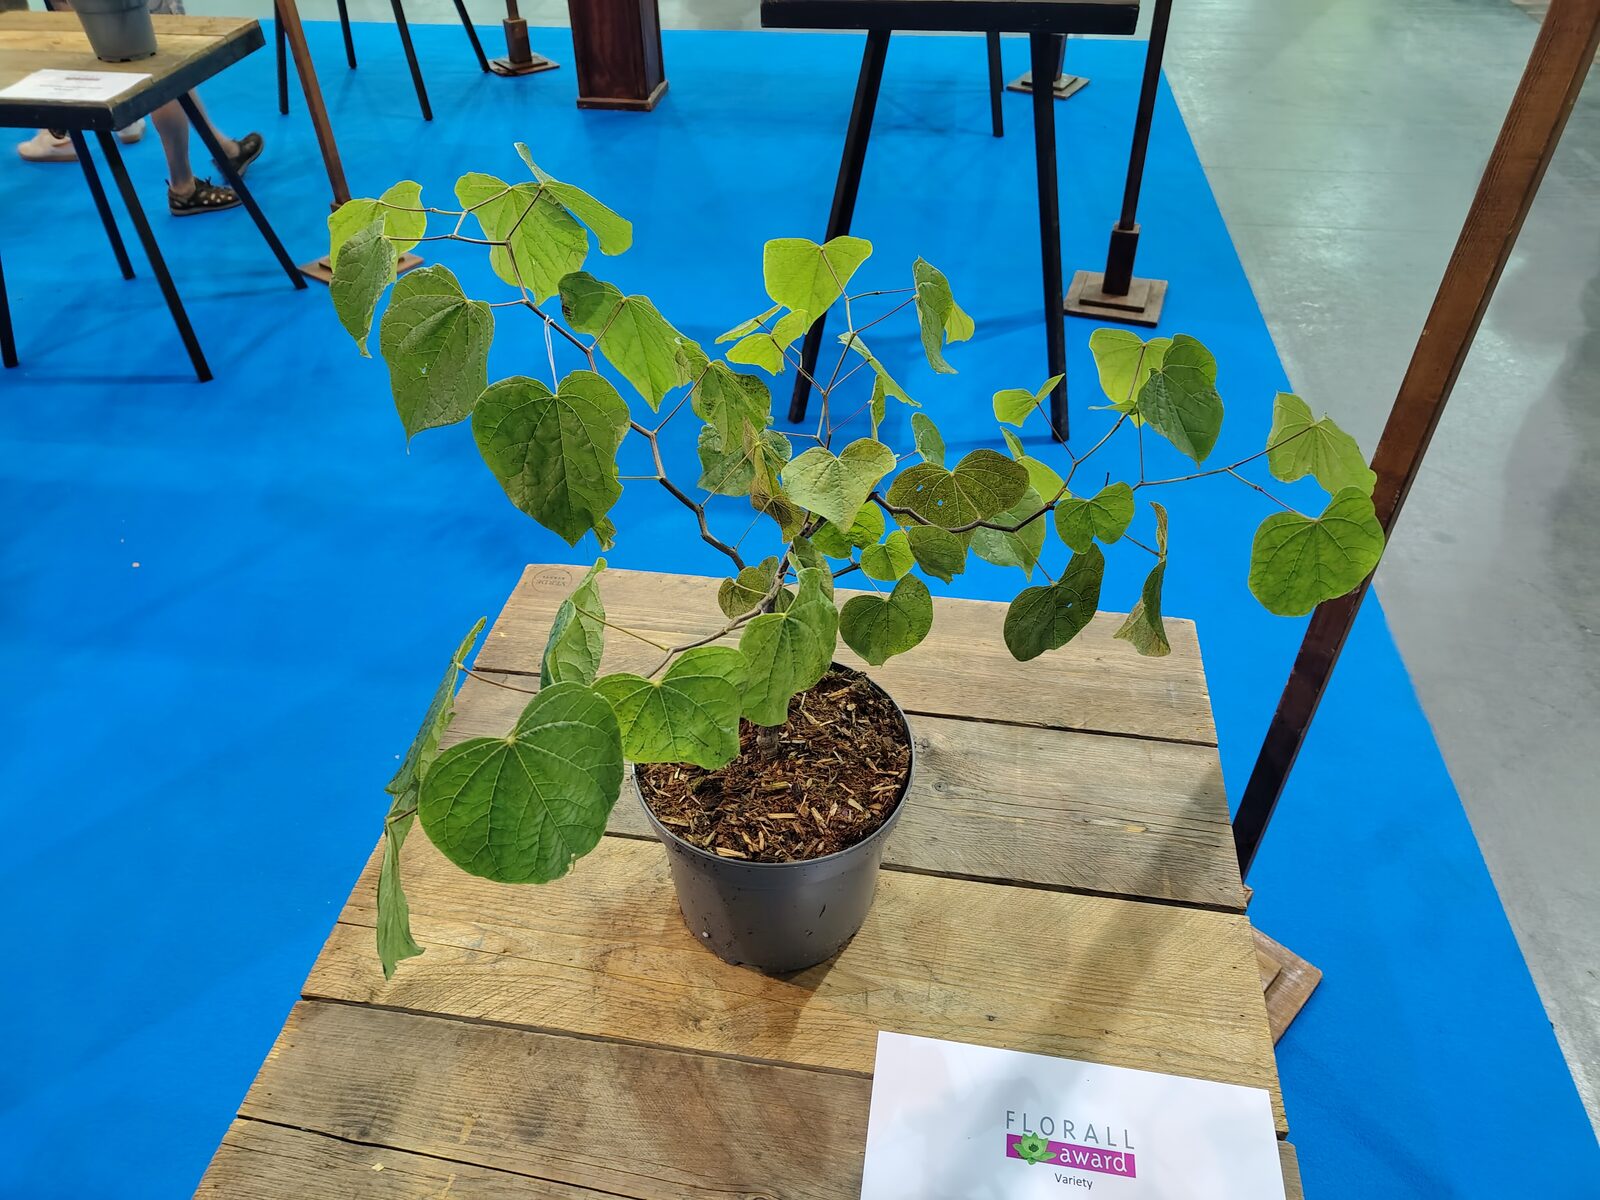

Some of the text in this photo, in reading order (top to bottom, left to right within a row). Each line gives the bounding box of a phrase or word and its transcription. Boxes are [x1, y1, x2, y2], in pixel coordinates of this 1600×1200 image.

[1006, 1110, 1135, 1150] FLORALL
[1059, 1148, 1128, 1173] award
[1054, 1172, 1093, 1190] Variety
